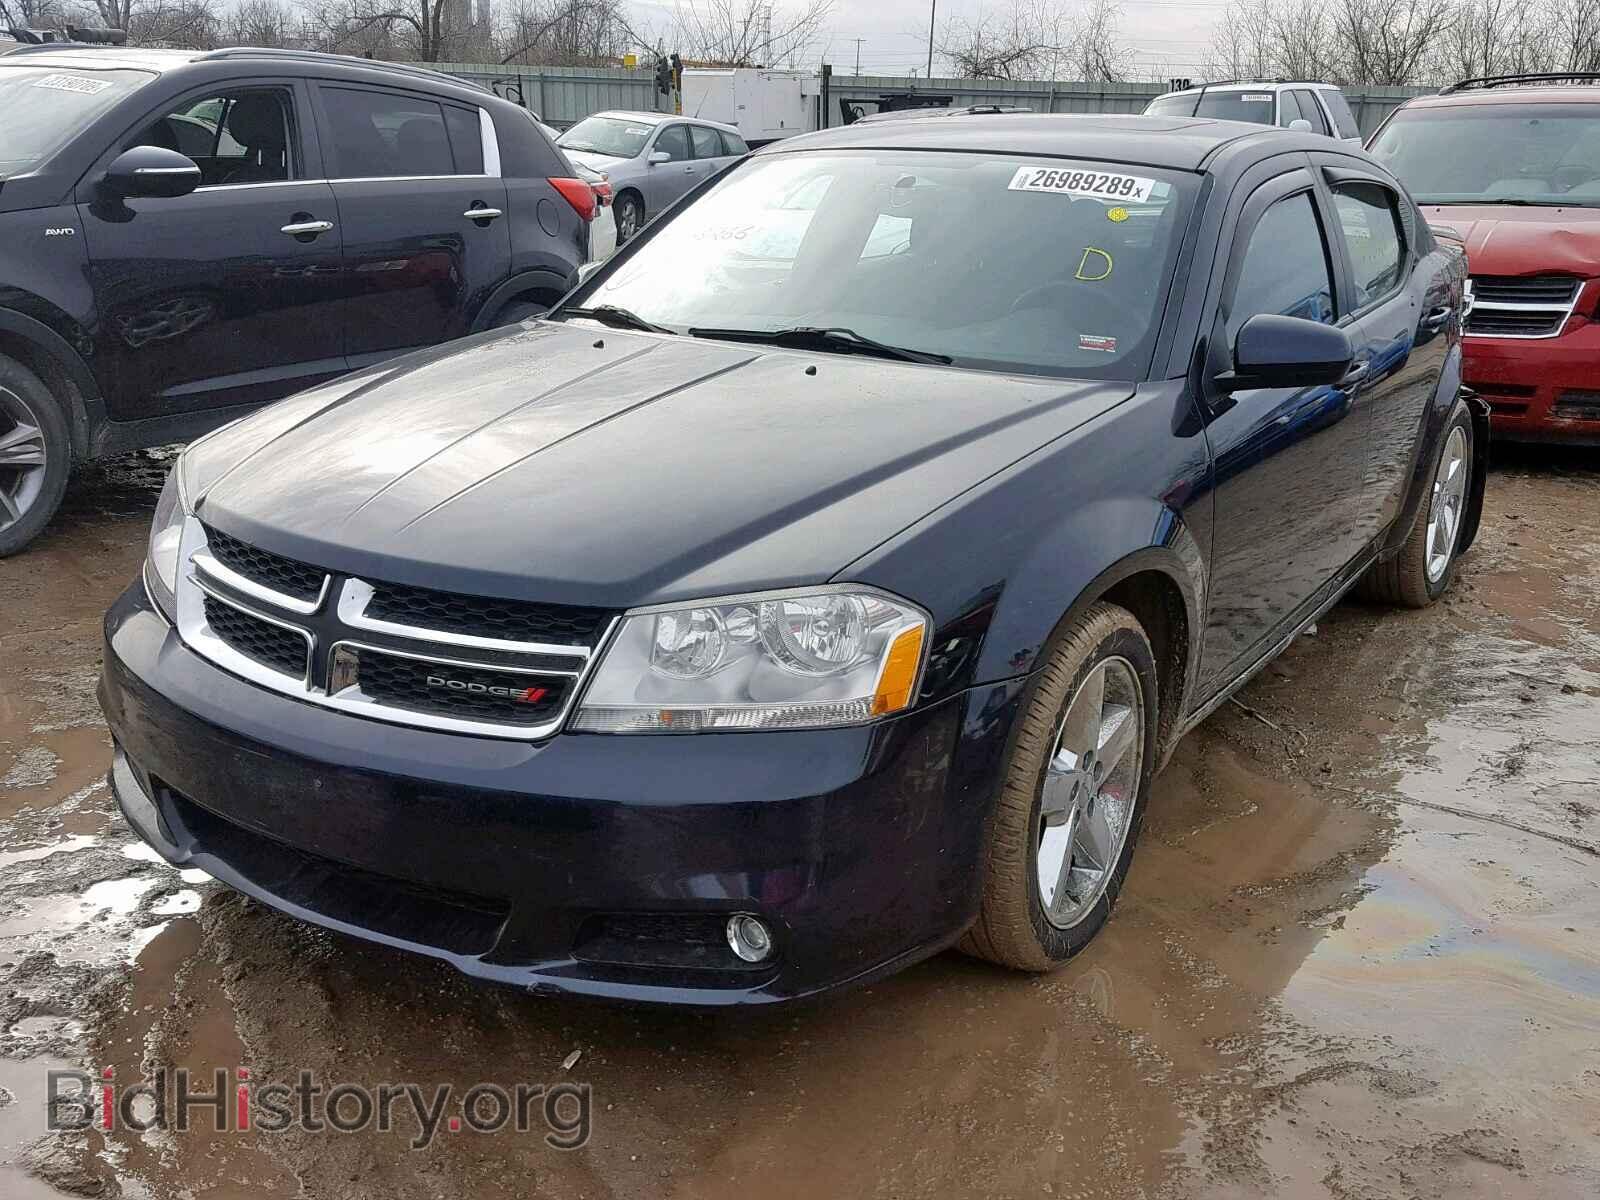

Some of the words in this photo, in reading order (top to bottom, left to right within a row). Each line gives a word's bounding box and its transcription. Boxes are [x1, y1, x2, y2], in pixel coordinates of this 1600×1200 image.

[45, 228, 74, 236] AWD
[1074, 247, 1112, 280] D
[426, 676, 529, 698] DODGE
